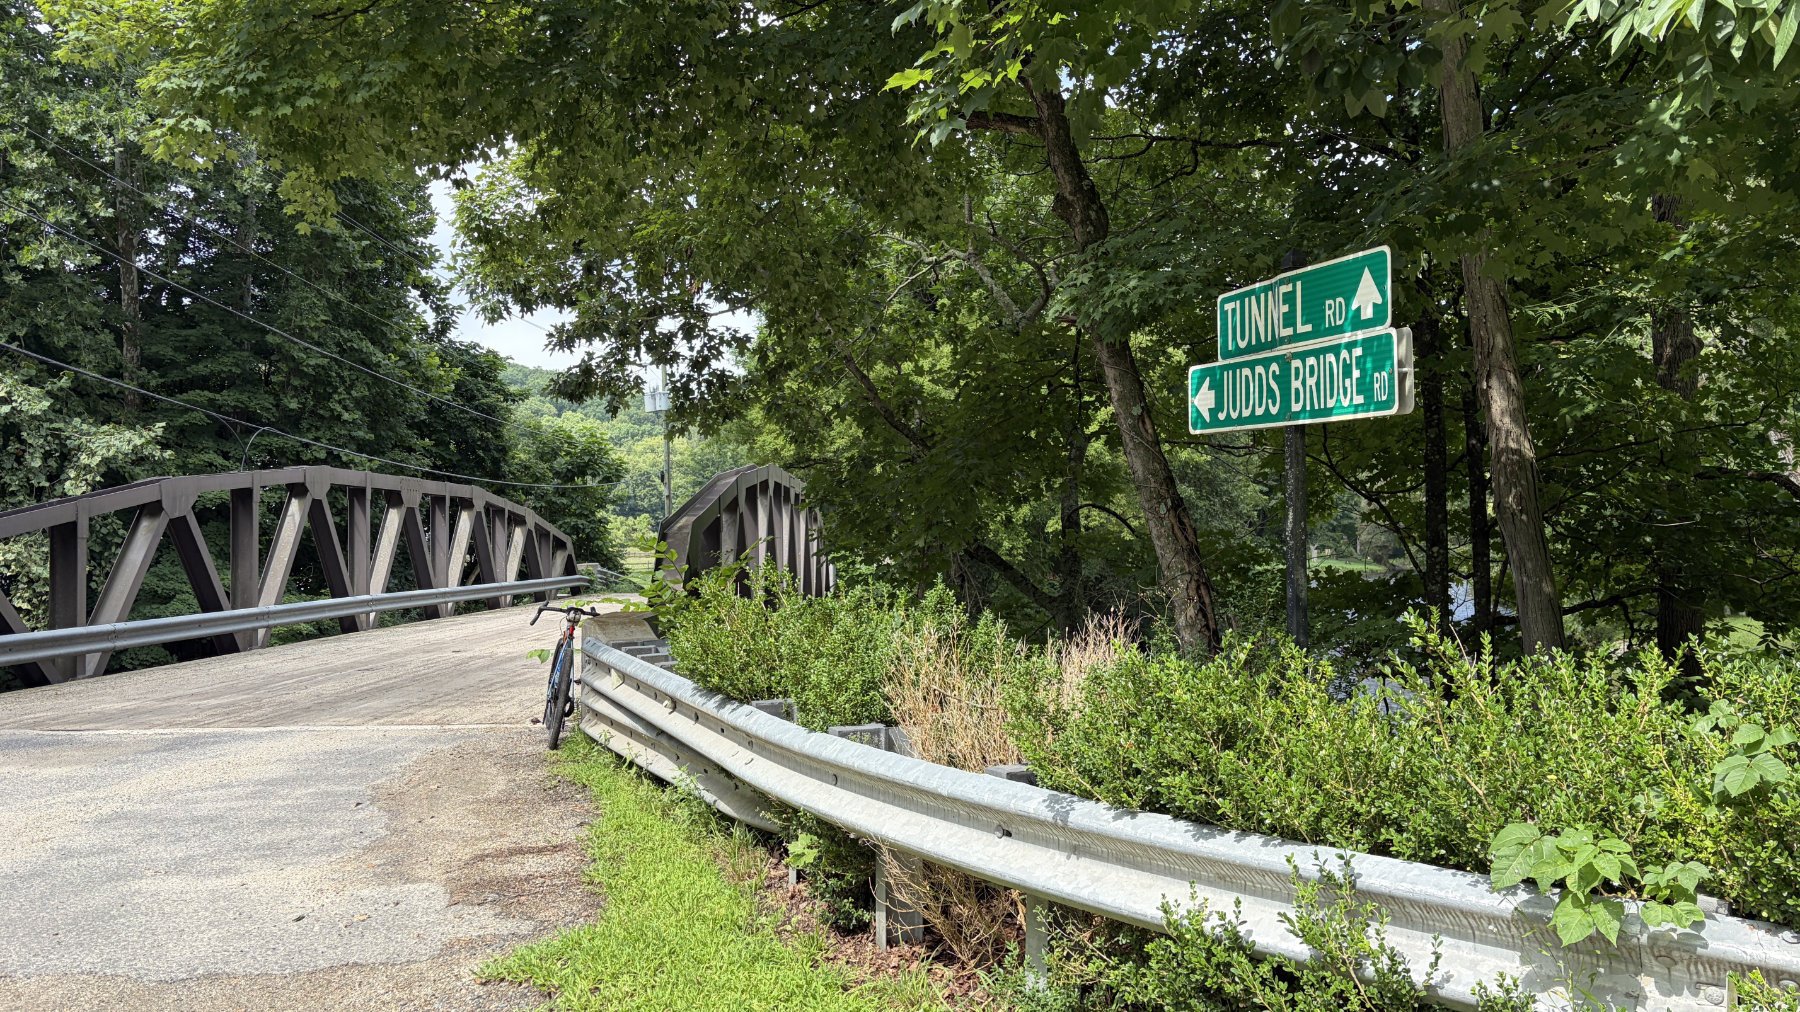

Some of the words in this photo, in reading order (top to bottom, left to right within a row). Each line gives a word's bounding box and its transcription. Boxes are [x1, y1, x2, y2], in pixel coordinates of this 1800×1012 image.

[1224, 281, 1312, 350] TUNNEL
[1325, 297, 1346, 328] RD
[1218, 362, 1280, 421] JUDDS
[1291, 347, 1364, 412] BRIDGE
[1373, 371, 1388, 402] RD
